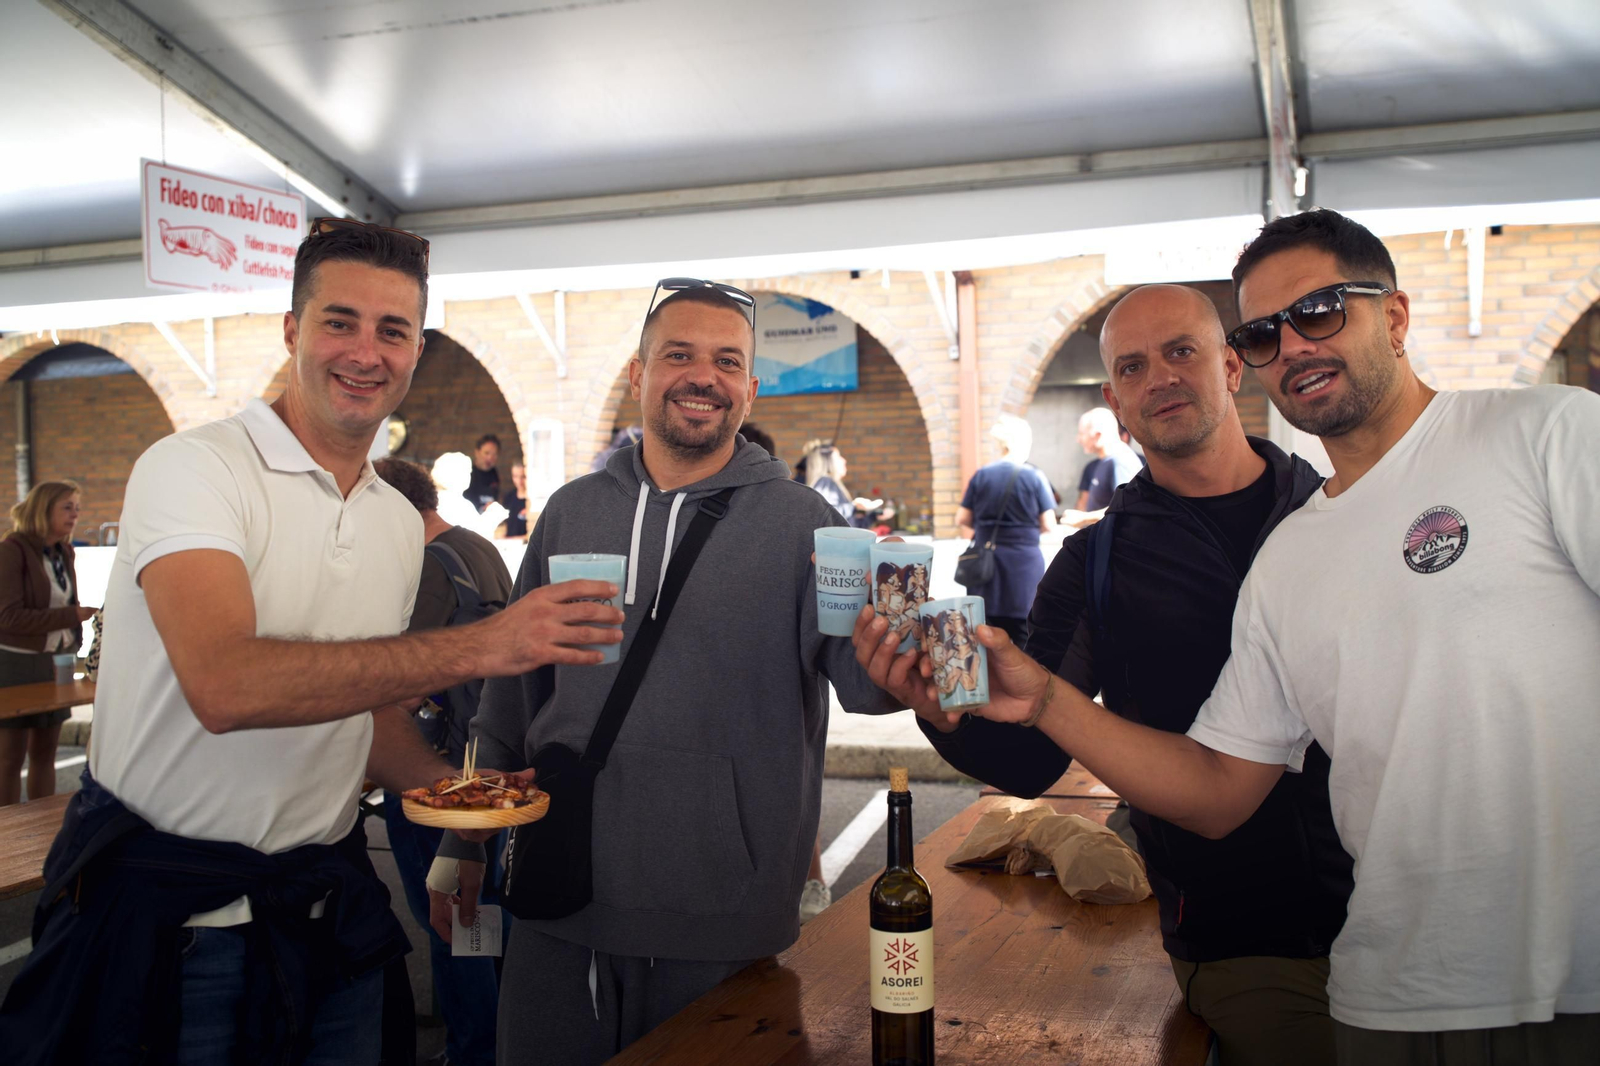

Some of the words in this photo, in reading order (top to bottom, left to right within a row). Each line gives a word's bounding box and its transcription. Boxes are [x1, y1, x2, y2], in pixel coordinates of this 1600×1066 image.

[160, 177, 198, 209] Fideo
[201, 193, 225, 215] con
[1419, 543, 1454, 560] billabong
[820, 566, 846, 576] FESTA
[849, 569, 863, 577] DO
[816, 574, 867, 588] MARISCO
[820, 600, 826, 608] O
[827, 602, 859, 611] GROVE
[881, 976, 923, 987] ASOREI
